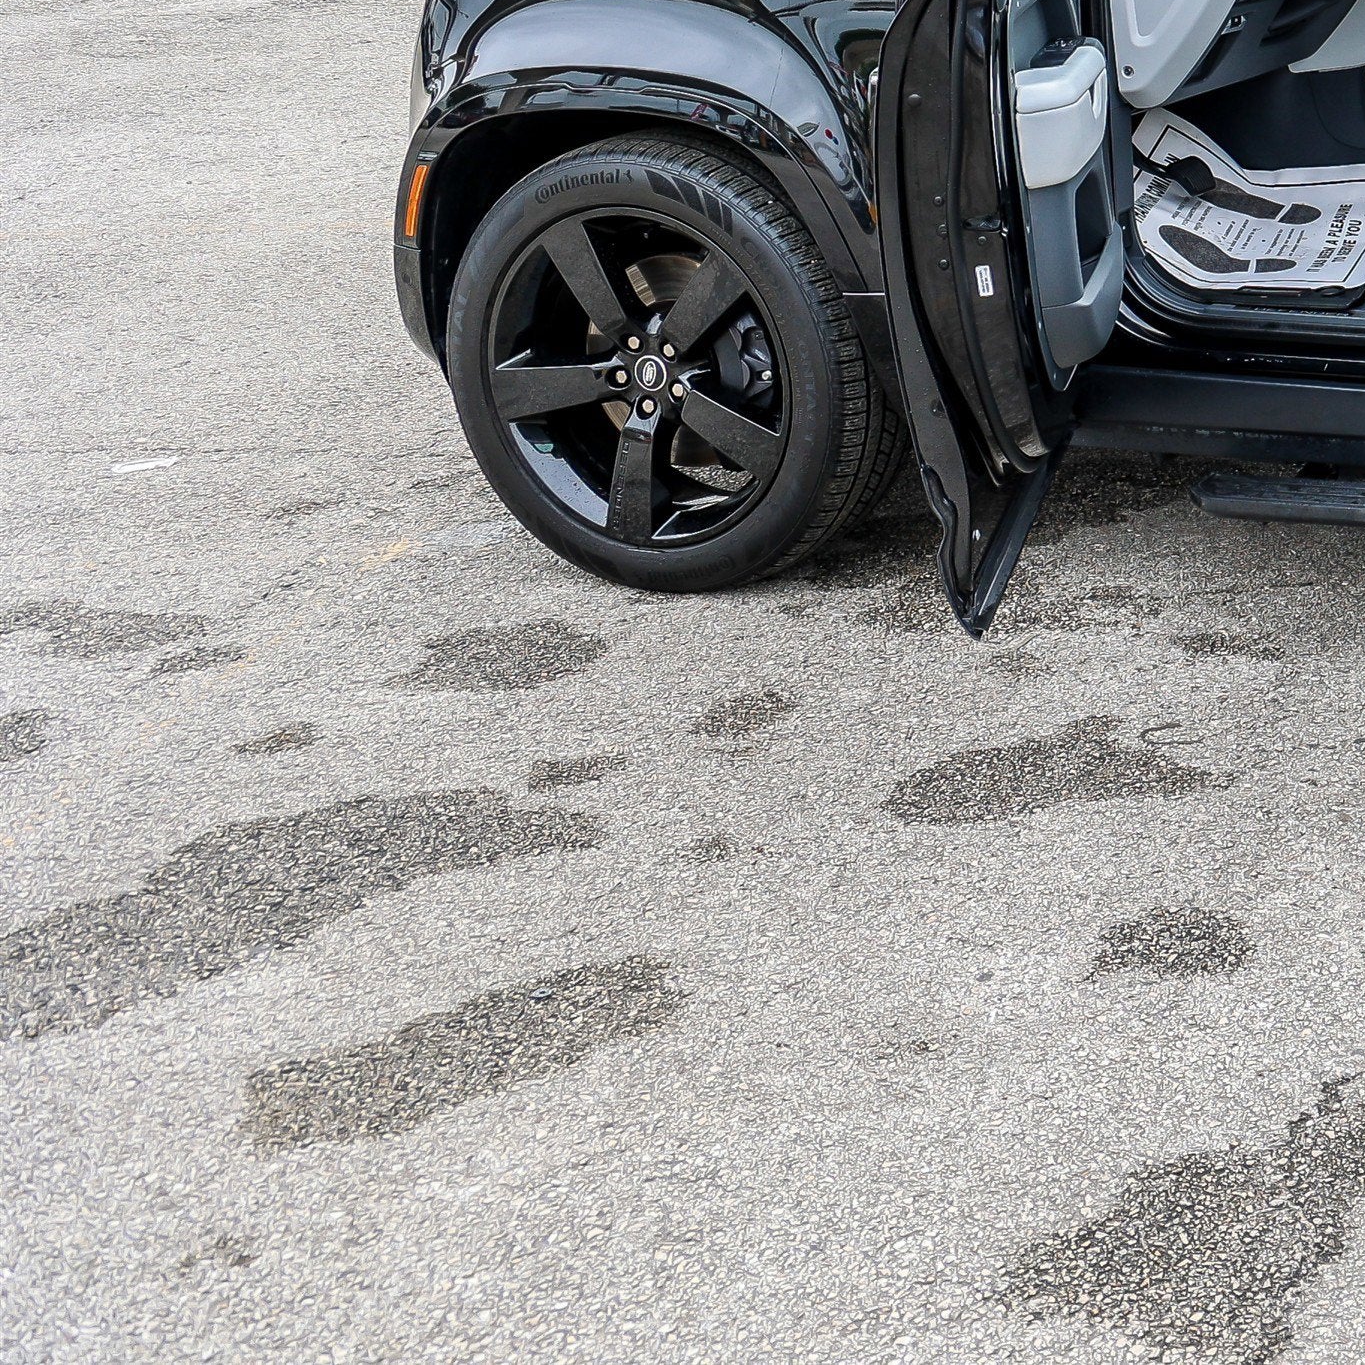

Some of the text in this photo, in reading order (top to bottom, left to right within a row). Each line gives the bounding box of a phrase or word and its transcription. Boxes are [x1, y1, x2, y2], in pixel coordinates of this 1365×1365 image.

[534, 168, 621, 204] Continental
[1327, 203, 1353, 238] PLEASURE
[1345, 219, 1362, 237] YOU
[613, 441, 631, 531] DEFENDER
